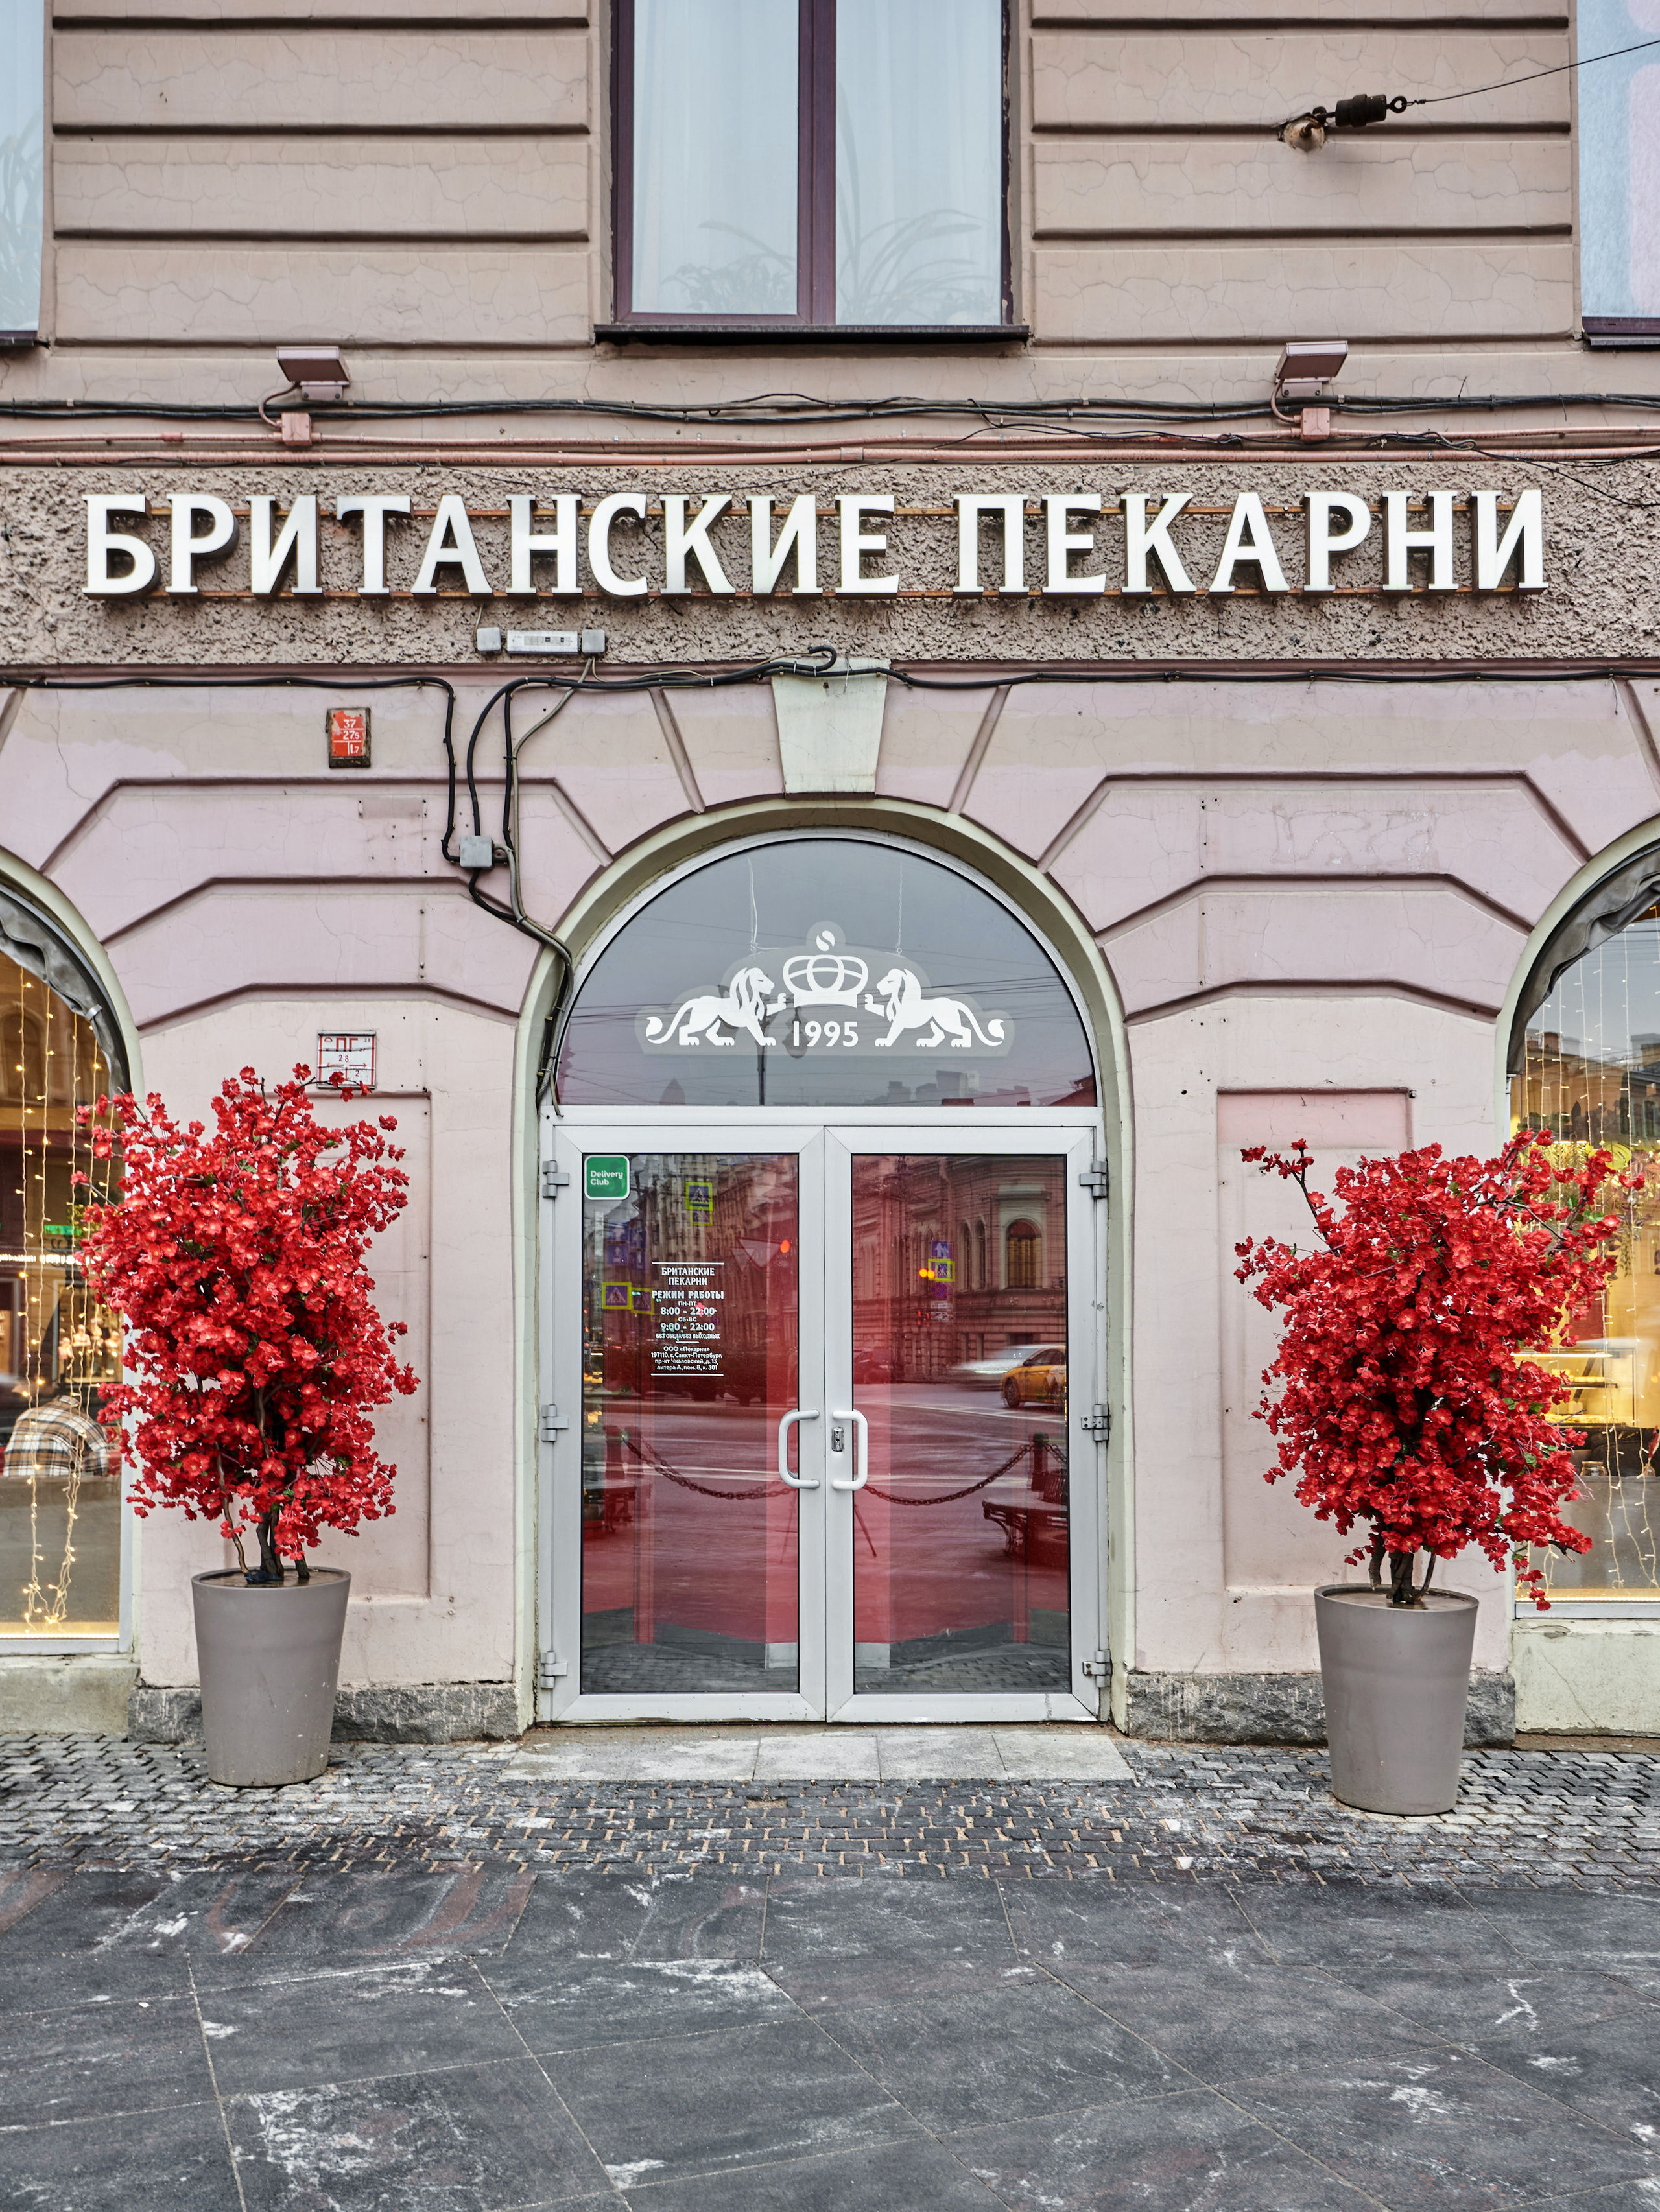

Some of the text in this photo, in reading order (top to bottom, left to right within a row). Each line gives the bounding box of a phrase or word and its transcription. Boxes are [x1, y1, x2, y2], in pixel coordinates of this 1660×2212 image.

[82, 488, 1548, 598] БРИТАНСКИЕ ПЕКАРНИ
[343, 719, 356, 728] 37
[792, 1020, 859, 1047] 1995
[590, 1170, 623, 1179] Delivery
[661, 1267, 715, 1276] БРИТАНСКИЕ
[668, 1277, 708, 1286] ПЕКАРНИ
[652, 1290, 724, 1299] РЕЖИМ РАБОТЫ
[660, 1306, 681, 1315] 8:00
[690, 1306, 715, 1315] 22:00
[660, 1323, 680, 1331] 9:00
[689, 1323, 715, 1331] 22:00
